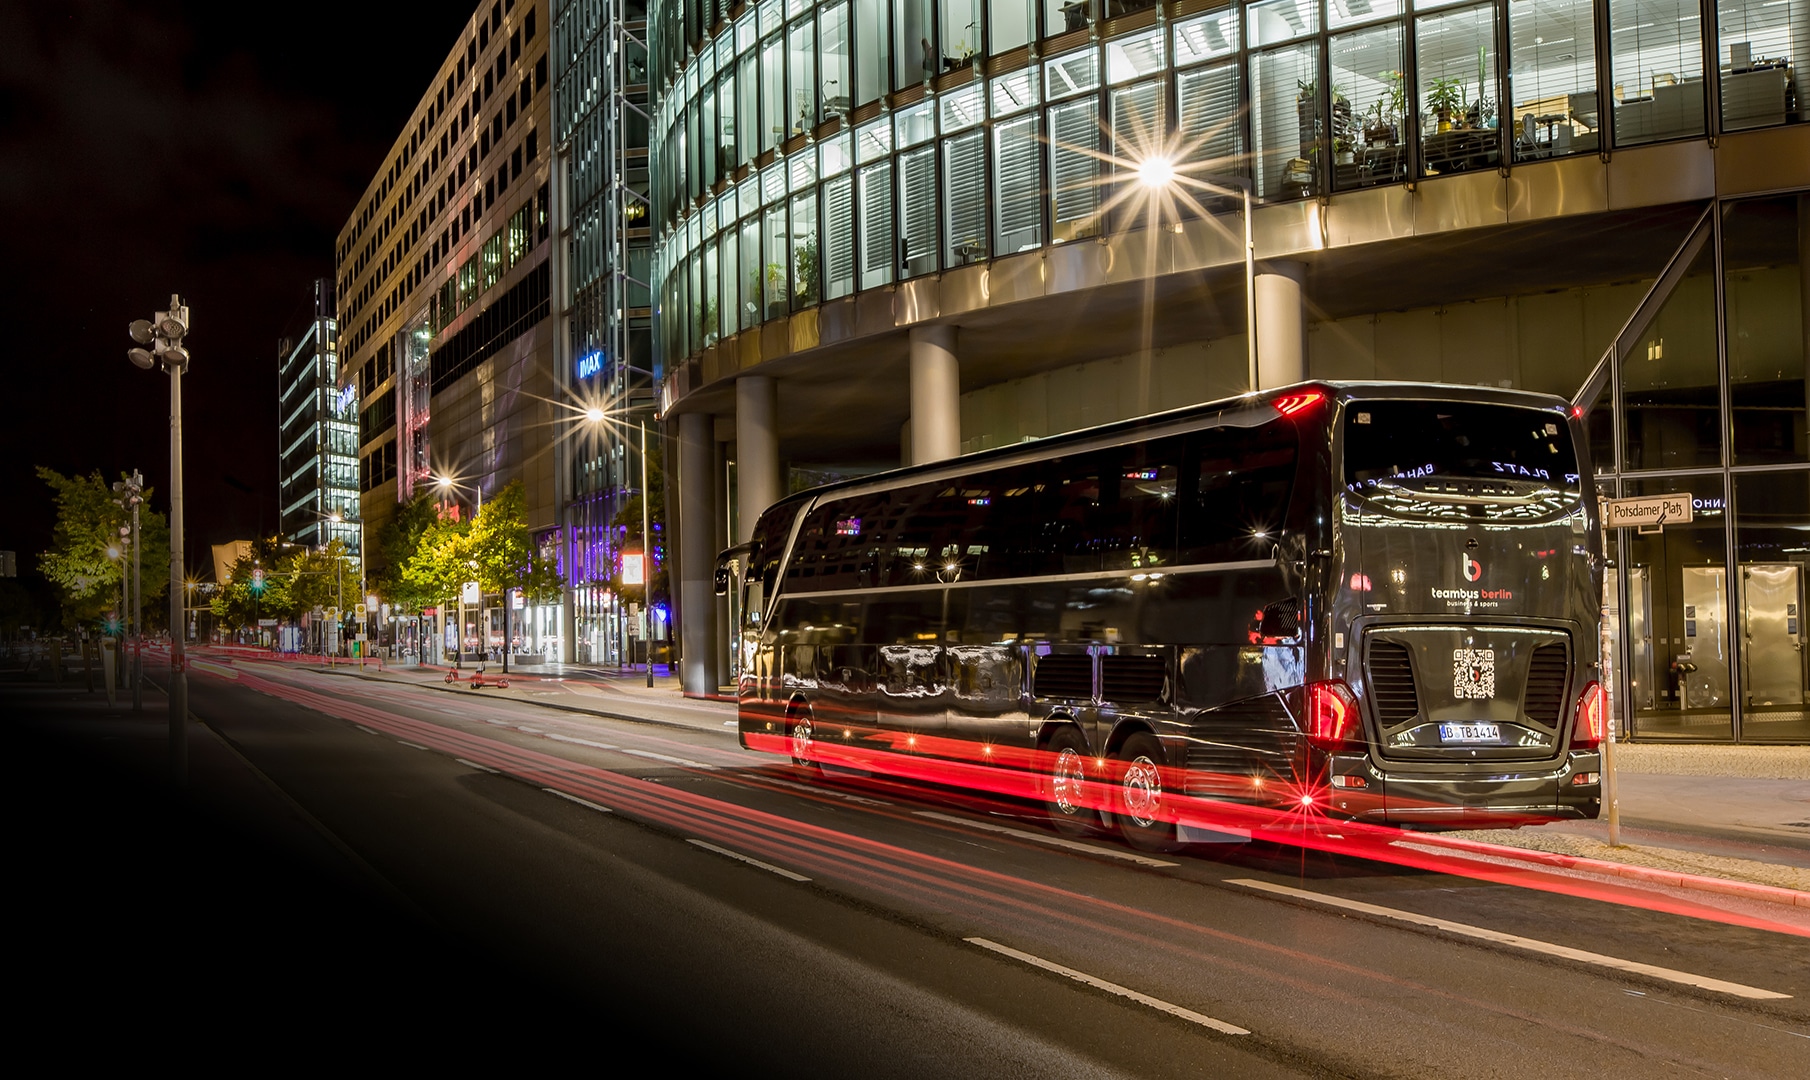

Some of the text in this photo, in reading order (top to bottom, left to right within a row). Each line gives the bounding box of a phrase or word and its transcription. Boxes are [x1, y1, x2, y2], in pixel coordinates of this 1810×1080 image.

[580, 351, 601, 379] IMAX
[1614, 501, 1682, 518] Potsdamer Platz
[1431, 587, 1512, 599] teambus berlin
[1446, 727, 1453, 738] B
